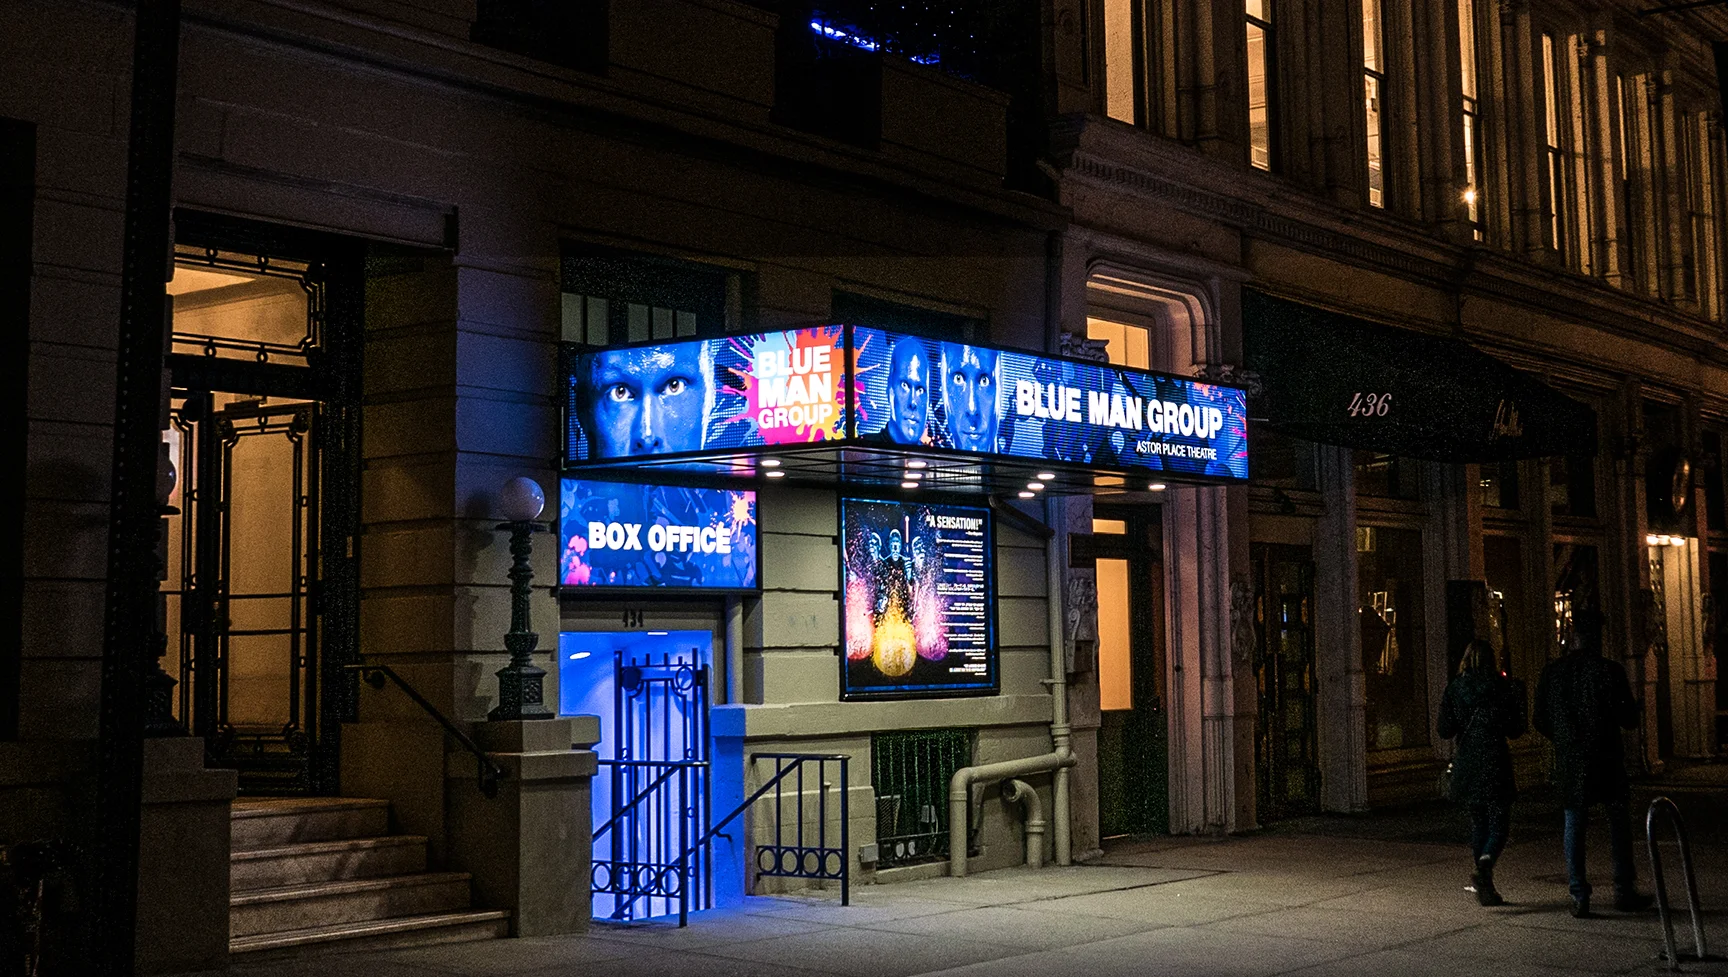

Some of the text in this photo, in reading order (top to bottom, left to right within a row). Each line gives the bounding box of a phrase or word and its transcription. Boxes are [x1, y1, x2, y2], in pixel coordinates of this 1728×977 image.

[758, 345, 831, 377] BLUE
[758, 372, 832, 408] MAN
[1347, 392, 1392, 417] 436
[758, 403, 832, 429] GROUP
[1016, 379, 1223, 439] BLUE MAN GROUP
[1136, 440, 1217, 460] ASTOR PLACE THEATRE
[588, 521, 731, 554] BOX OFFICE
